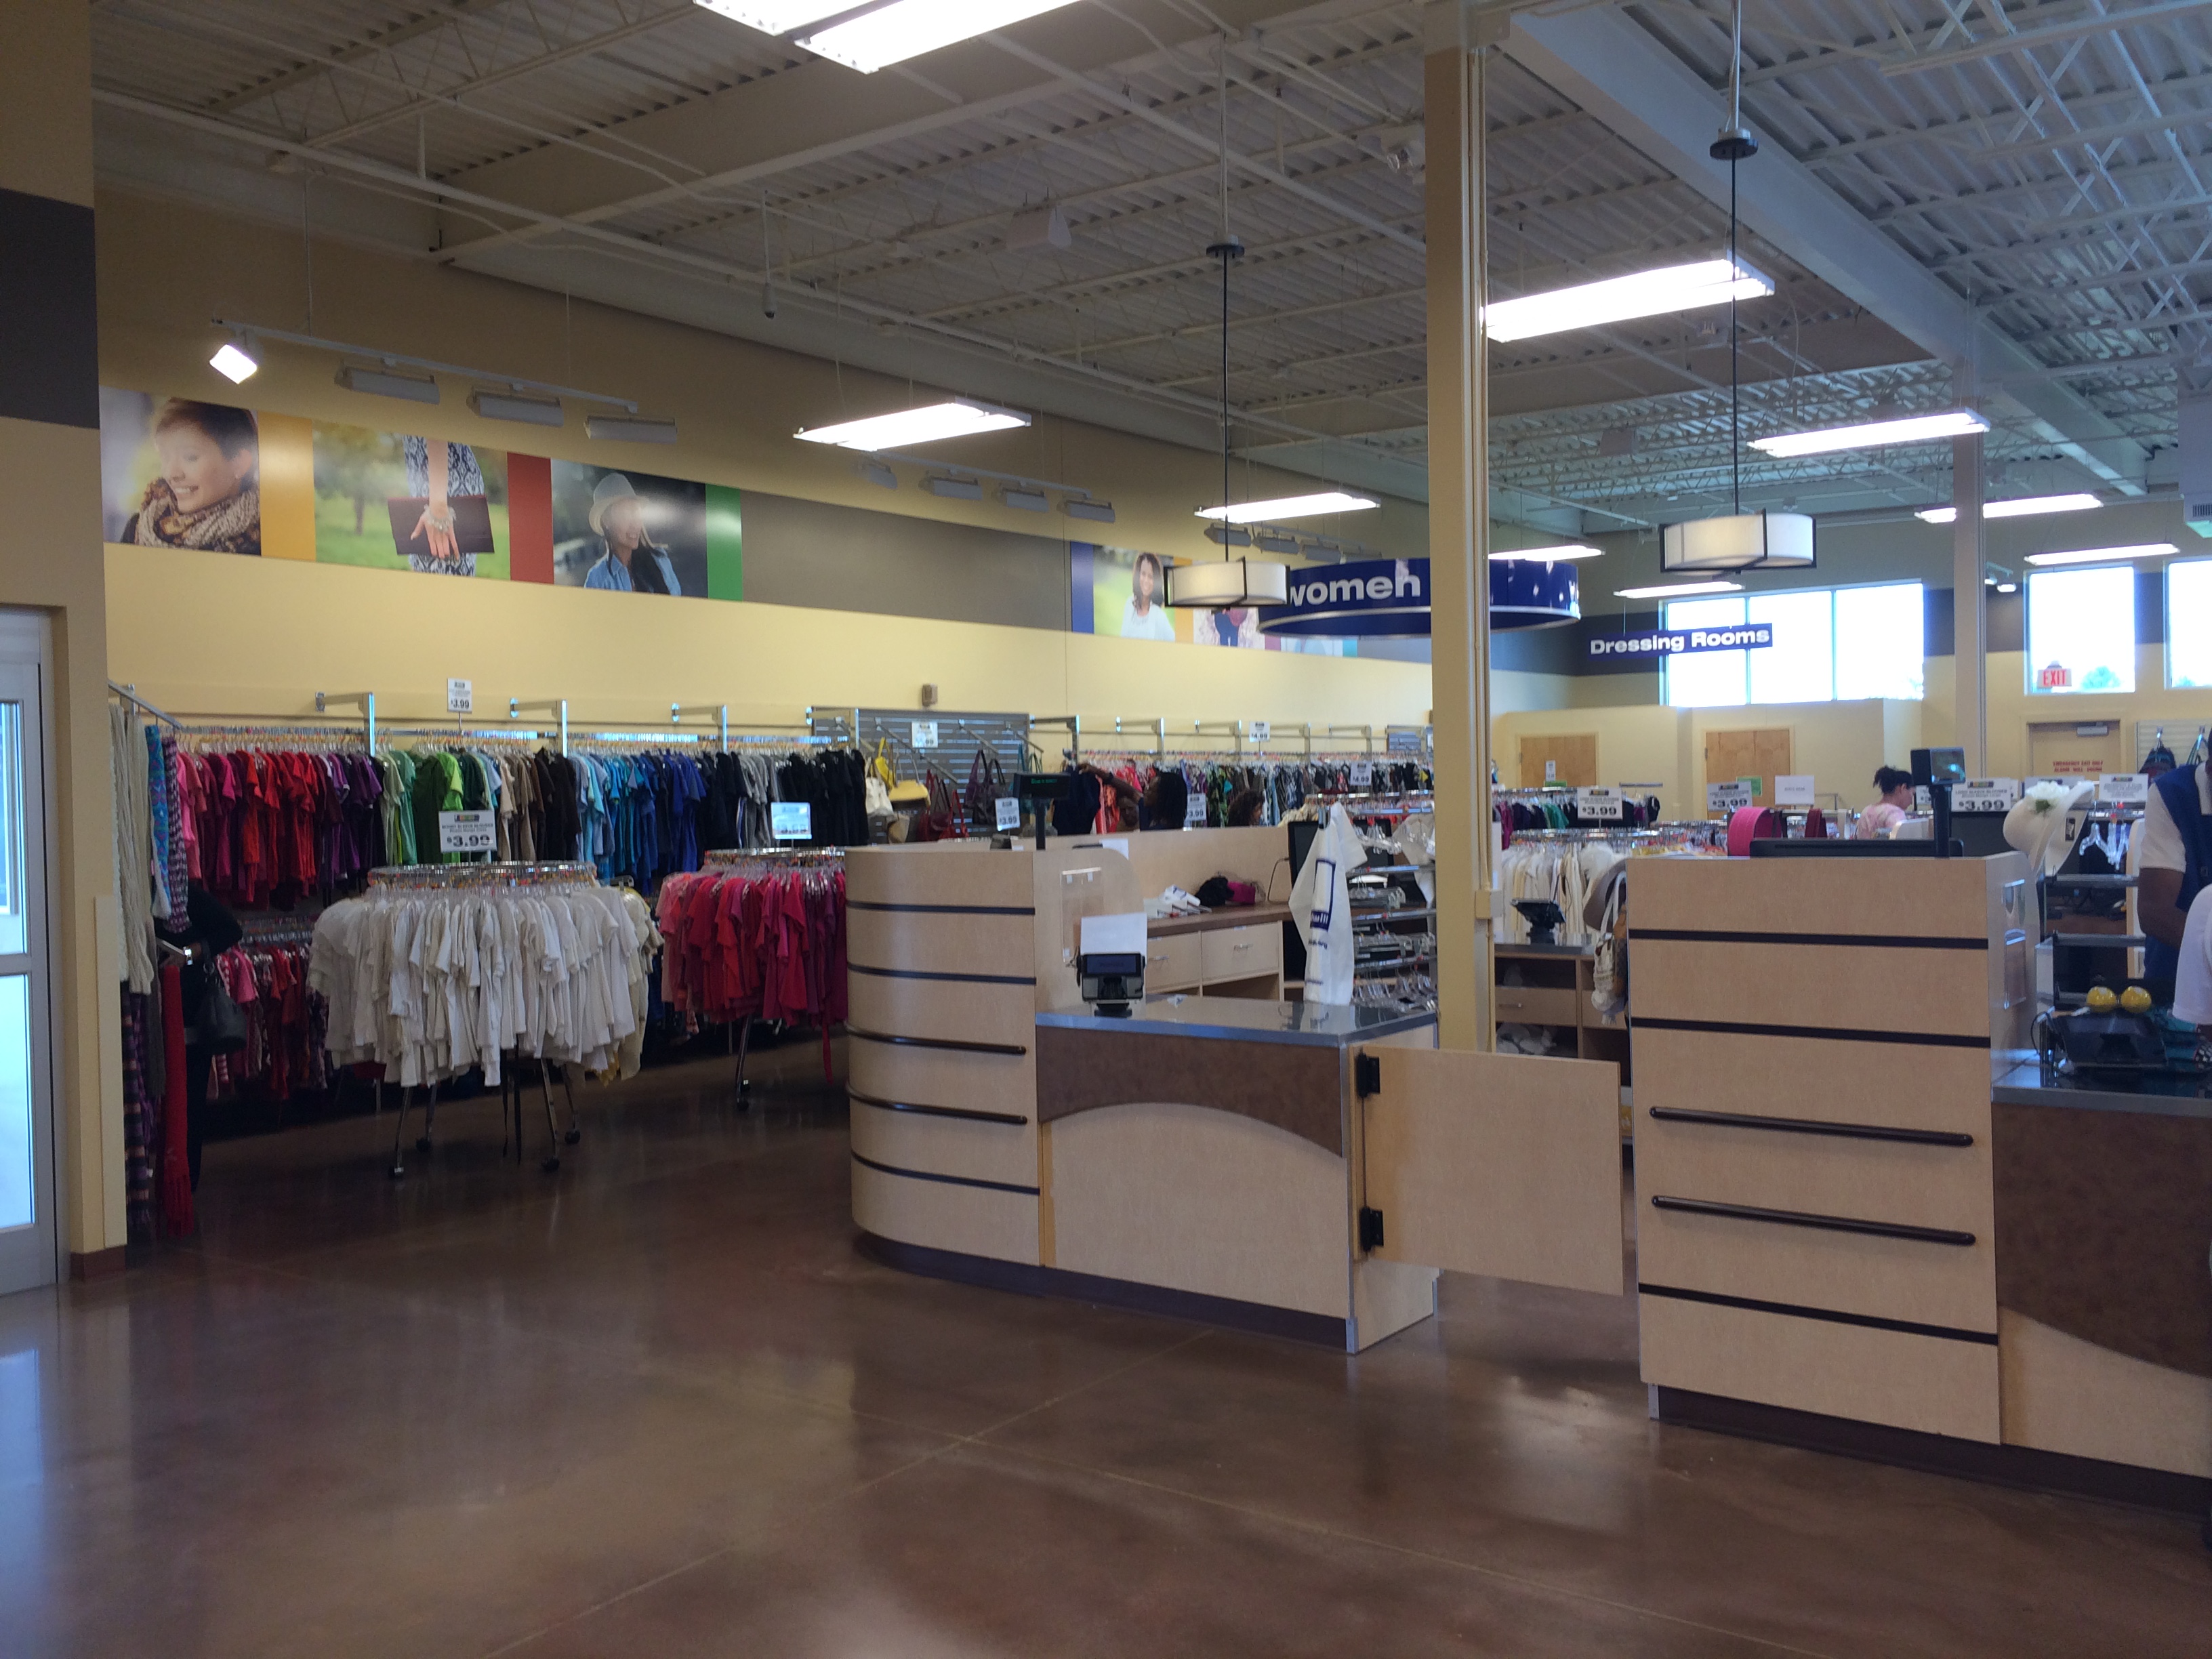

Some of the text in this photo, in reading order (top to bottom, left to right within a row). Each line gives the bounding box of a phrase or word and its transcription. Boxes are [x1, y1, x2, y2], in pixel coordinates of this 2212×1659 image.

[1290, 574, 1420, 607] women
[1590, 629, 1770, 655] Dressing Rooms
[2043, 670, 2066, 686] EXIT
